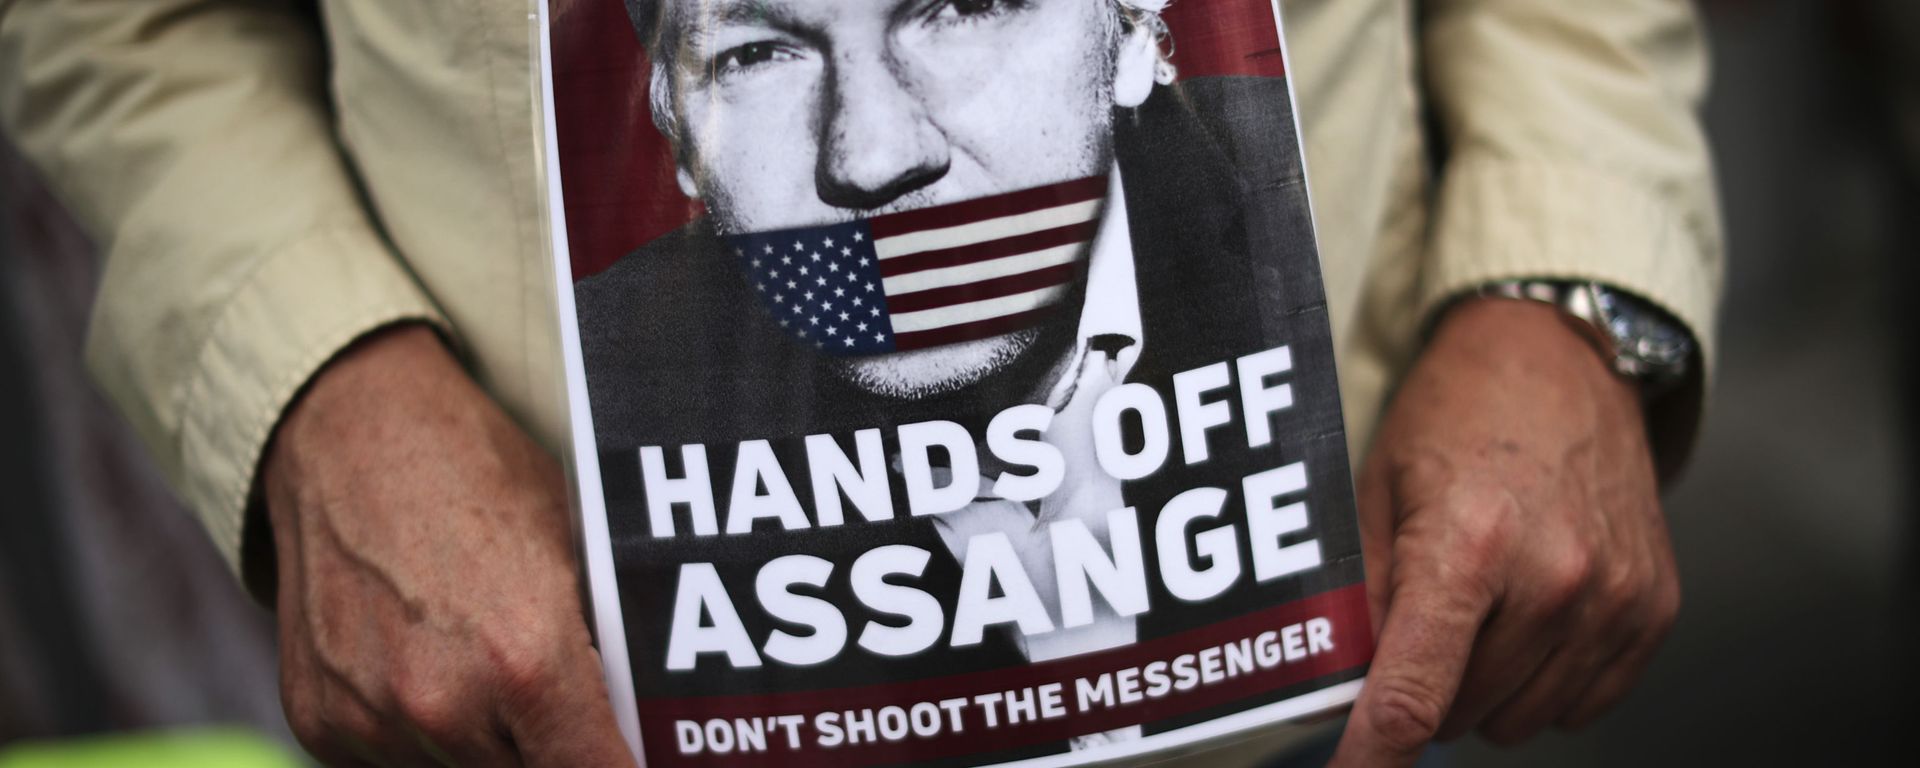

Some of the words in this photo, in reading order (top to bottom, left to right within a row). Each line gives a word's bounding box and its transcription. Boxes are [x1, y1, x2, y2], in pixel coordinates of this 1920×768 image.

[639, 404, 1066, 538] HANDS
[1093, 346, 1293, 479] OFF
[667, 462, 1321, 670] ASSANGE
[815, 697, 969, 748] SHOOT
[975, 682, 1067, 728] THE
[1075, 616, 1334, 714] MESSENGER
